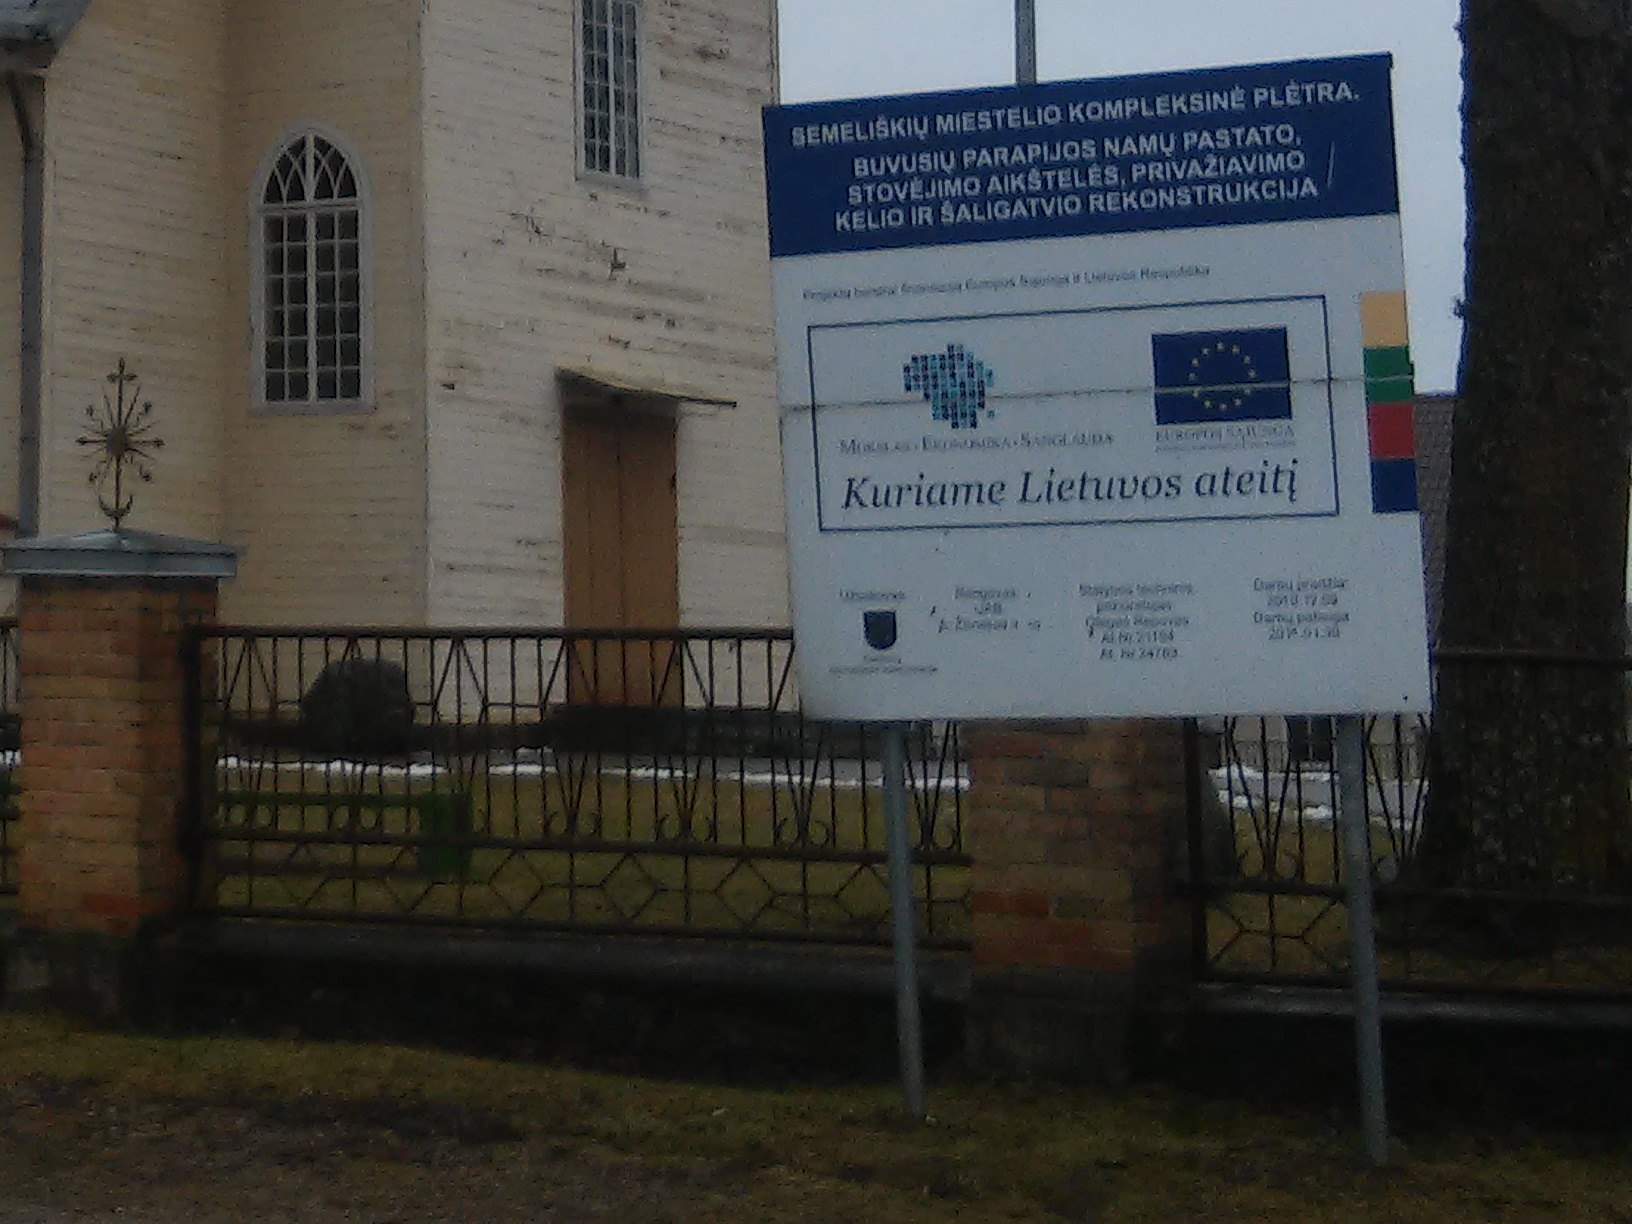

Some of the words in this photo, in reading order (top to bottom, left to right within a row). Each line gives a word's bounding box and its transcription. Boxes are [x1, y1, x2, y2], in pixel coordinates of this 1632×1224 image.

[791, 114, 928, 148] SEMELIŠKIŲ
[935, 102, 1062, 135] MIESTELIO
[1068, 83, 1247, 123] KOMPLEKSINĖ
[1254, 79, 1361, 108] PLĖTRA.
[848, 176, 981, 206] STOVĖJIMO
[986, 162, 1127, 195] AIKŠTELĖS,
[1131, 150, 1306, 183] PRIVAŽIAVIMO
[853, 149, 956, 178] BUVUSIŲ
[962, 139, 1097, 170] PARAPIJOS
[1103, 135, 1175, 158] NAMŲ
[1182, 124, 1303, 152] PASTATO,
[835, 208, 905, 233] KELIO
[911, 206, 935, 227] IR
[940, 196, 1082, 224] ŠALIGATVIO
[1088, 177, 1319, 214] REKONSTRUKCIJA
[841, 471, 1007, 510] Kuriame
[1015, 467, 1182, 504] Lietuvos
[1194, 458, 1299, 505] ateitį
